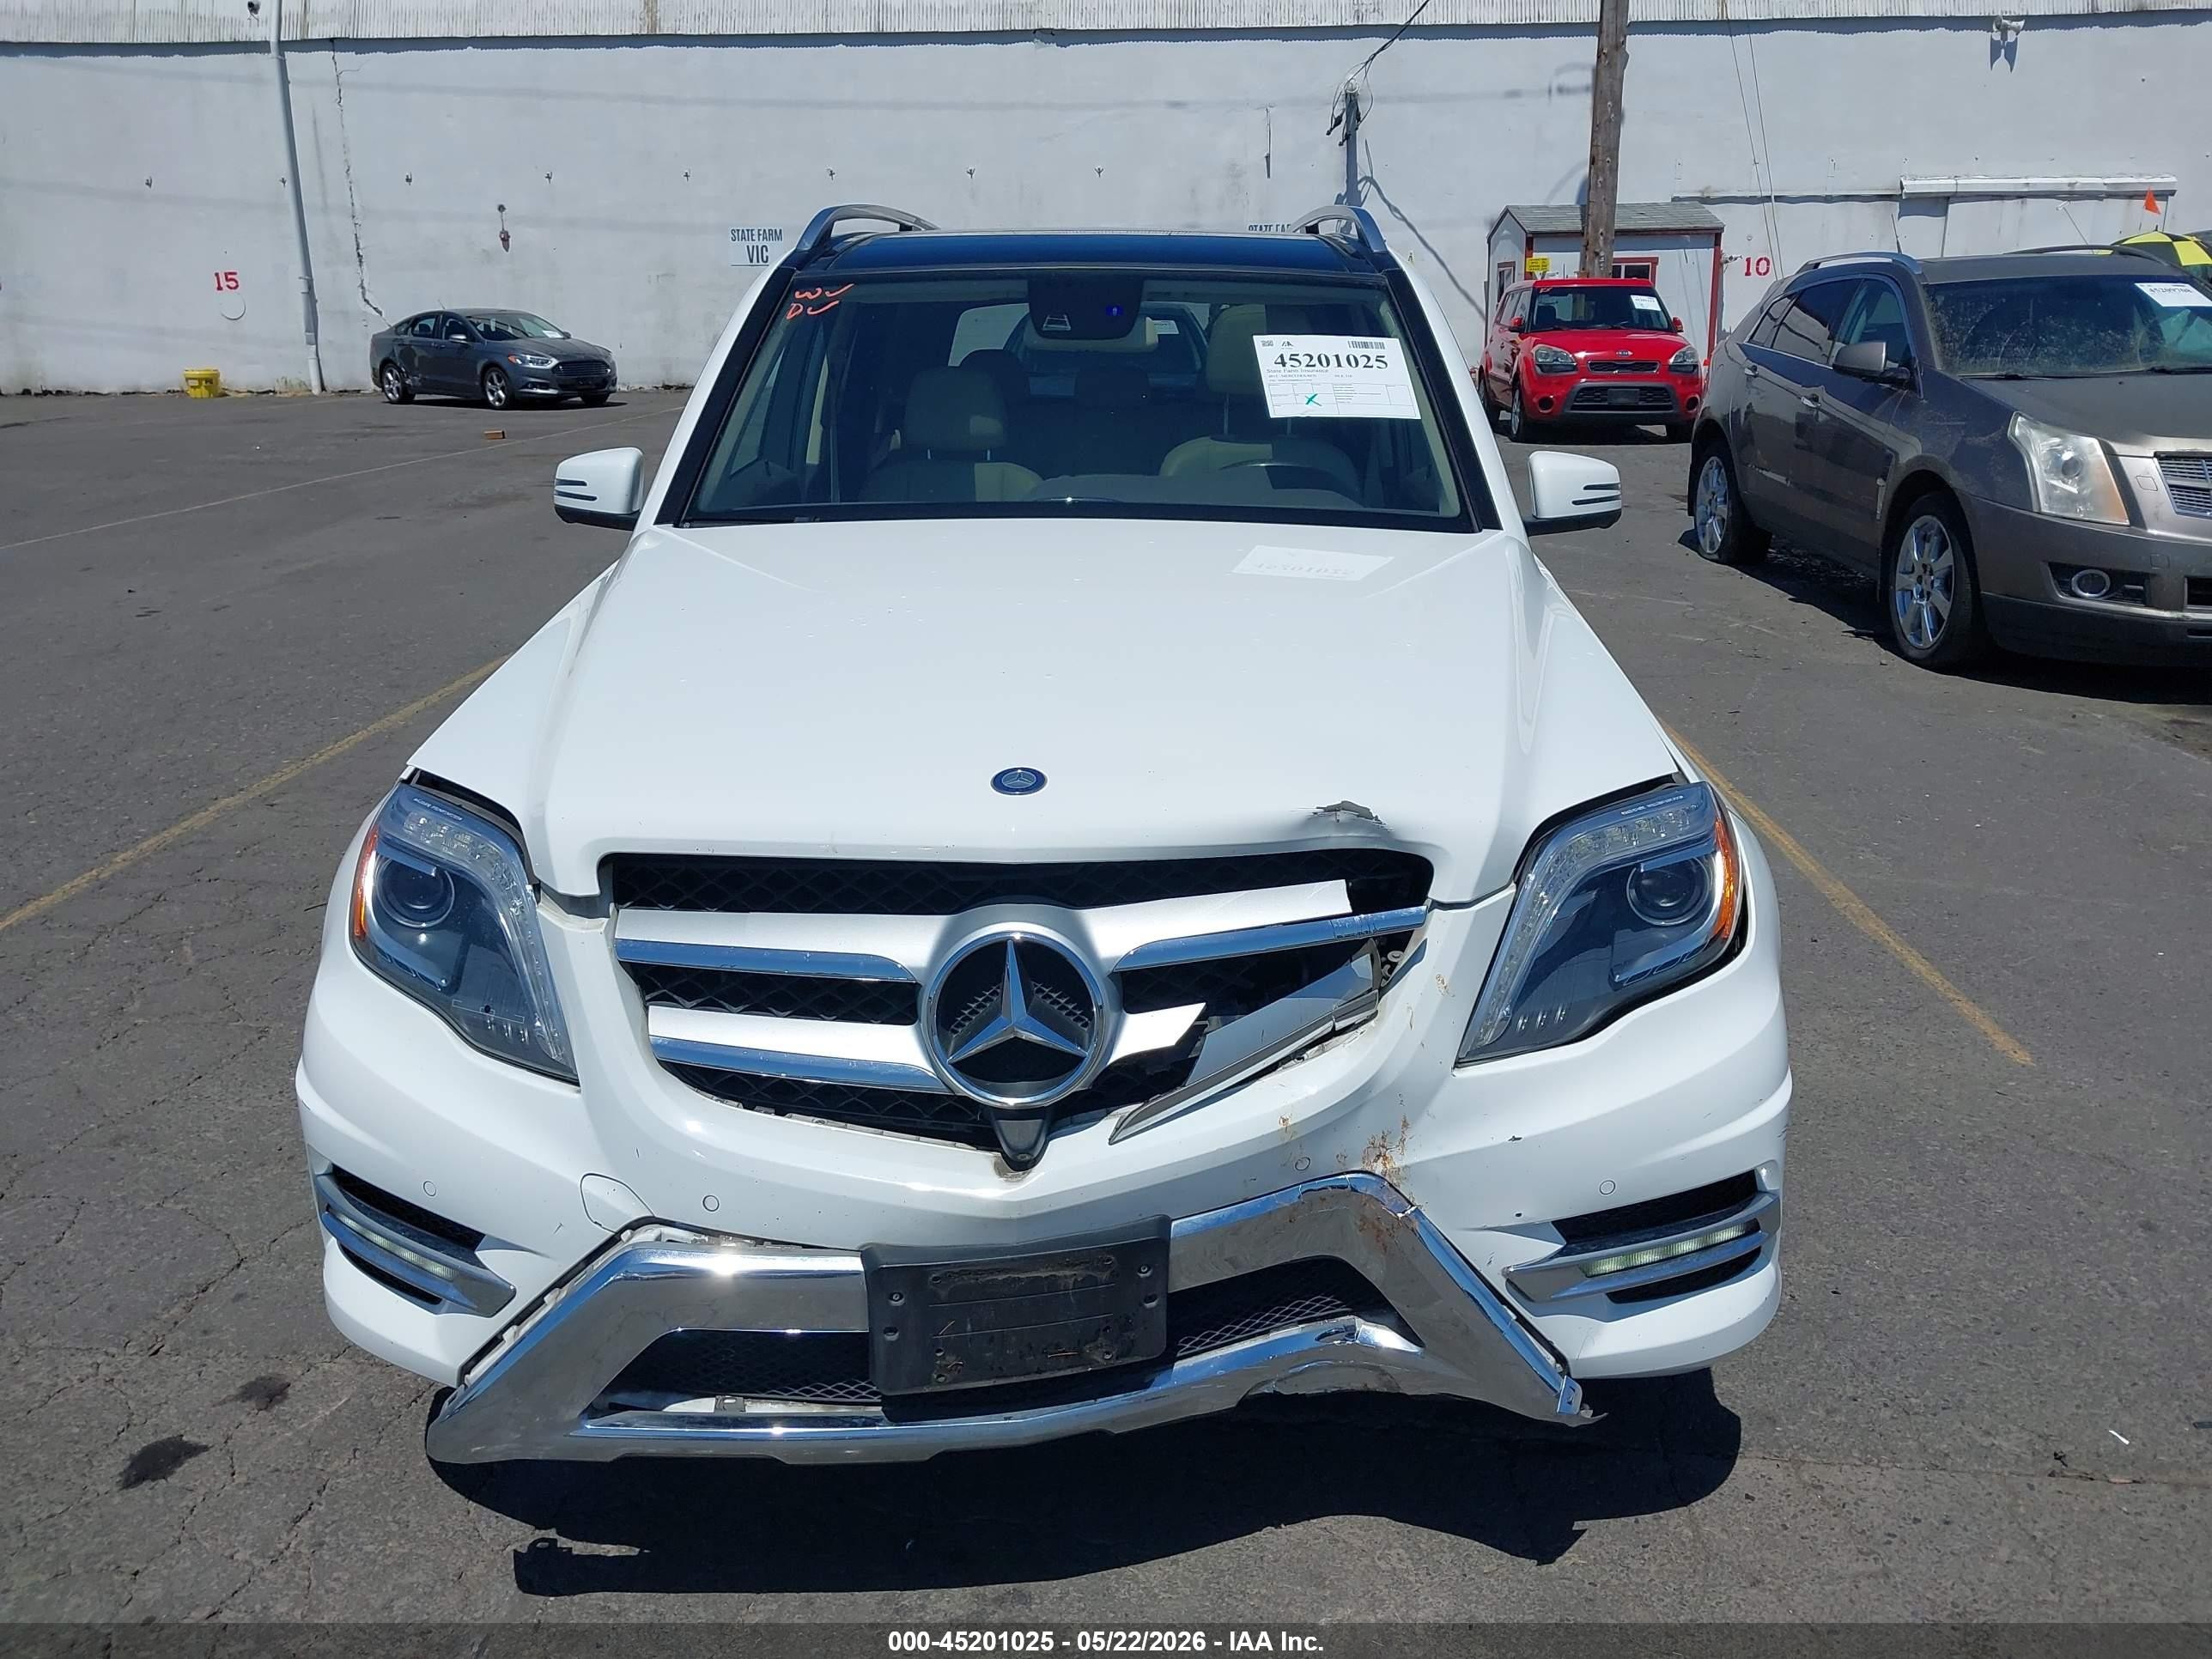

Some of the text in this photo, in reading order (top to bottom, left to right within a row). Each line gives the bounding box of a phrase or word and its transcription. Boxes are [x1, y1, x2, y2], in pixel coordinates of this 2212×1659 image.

[731, 228, 782, 242] STATE FARM
[746, 245, 769, 264] VIC
[1745, 257, 1771, 276] 10
[214, 271, 240, 291] 15
[1273, 352, 1389, 370] 45201025
